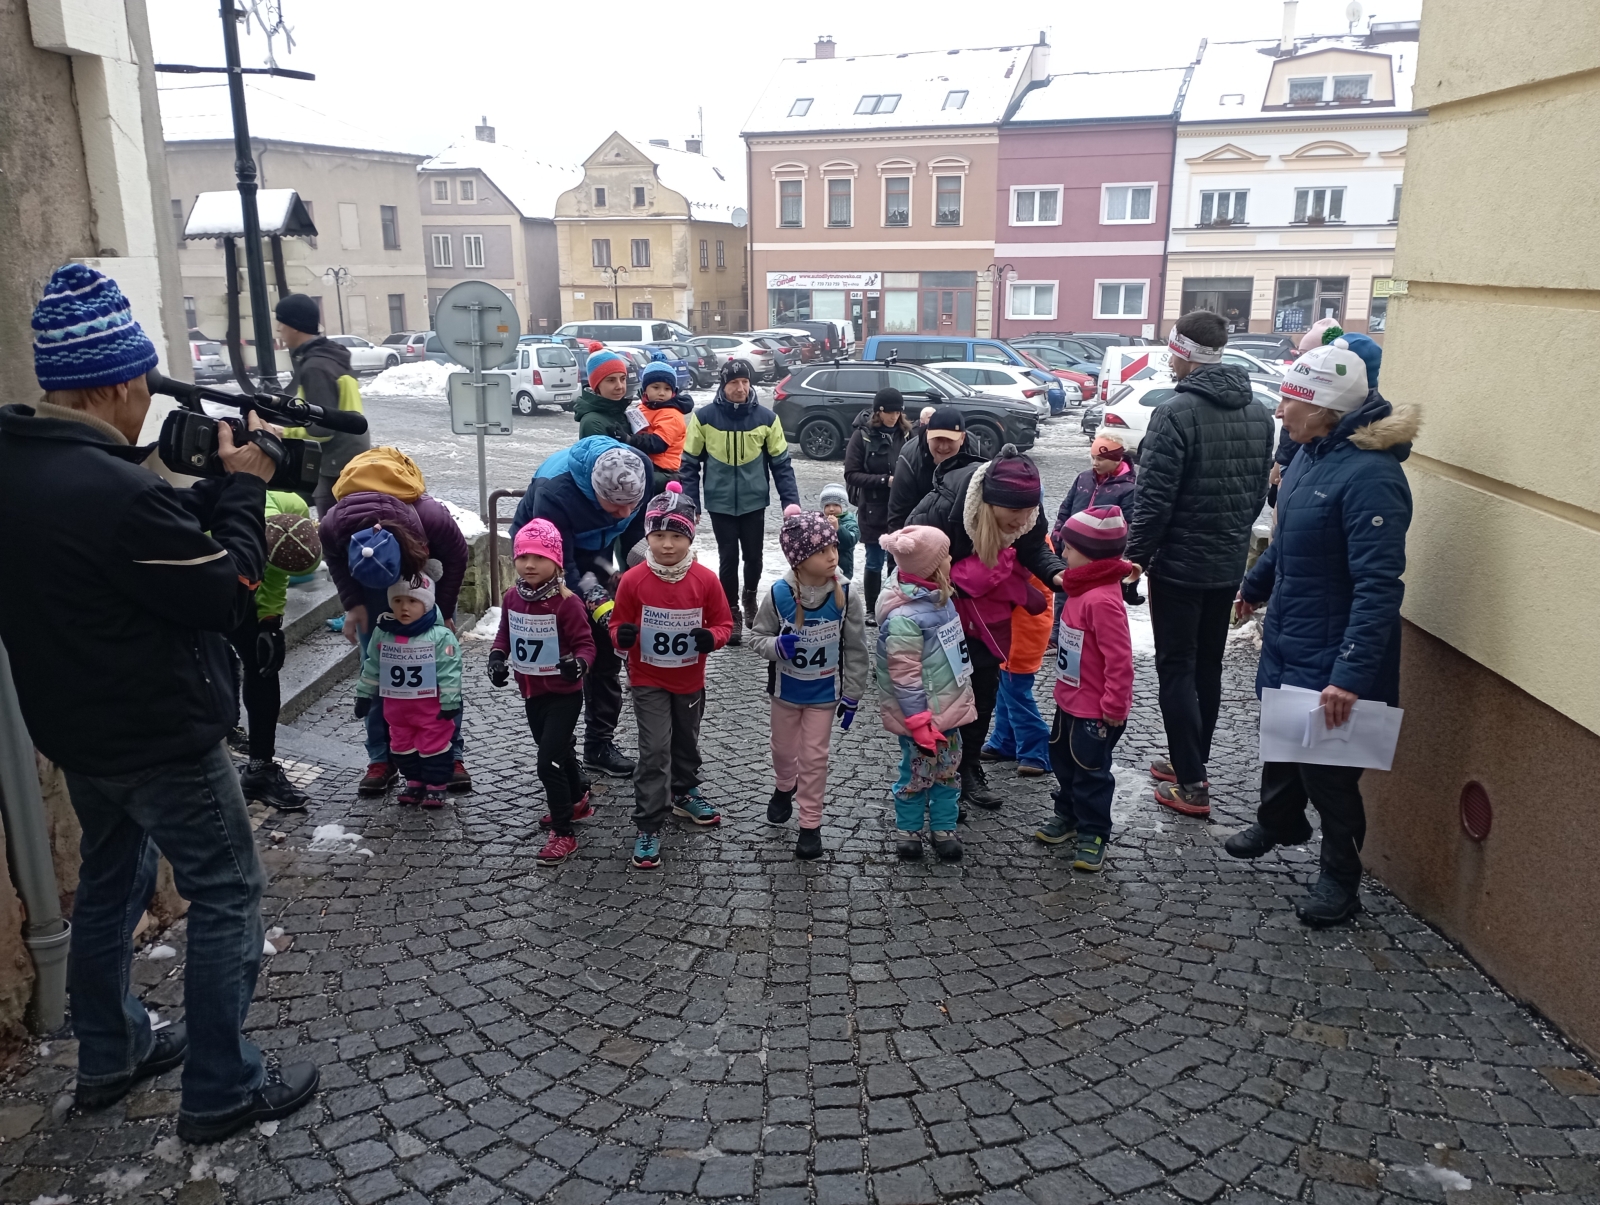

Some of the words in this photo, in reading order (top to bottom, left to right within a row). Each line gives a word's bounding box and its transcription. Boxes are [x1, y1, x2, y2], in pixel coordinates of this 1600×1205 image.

[653, 632, 689, 656] 86
[820, 632, 837, 641] LIGA
[515, 638, 544, 663] 67
[791, 646, 828, 669] 64
[390, 665, 423, 688] 93
